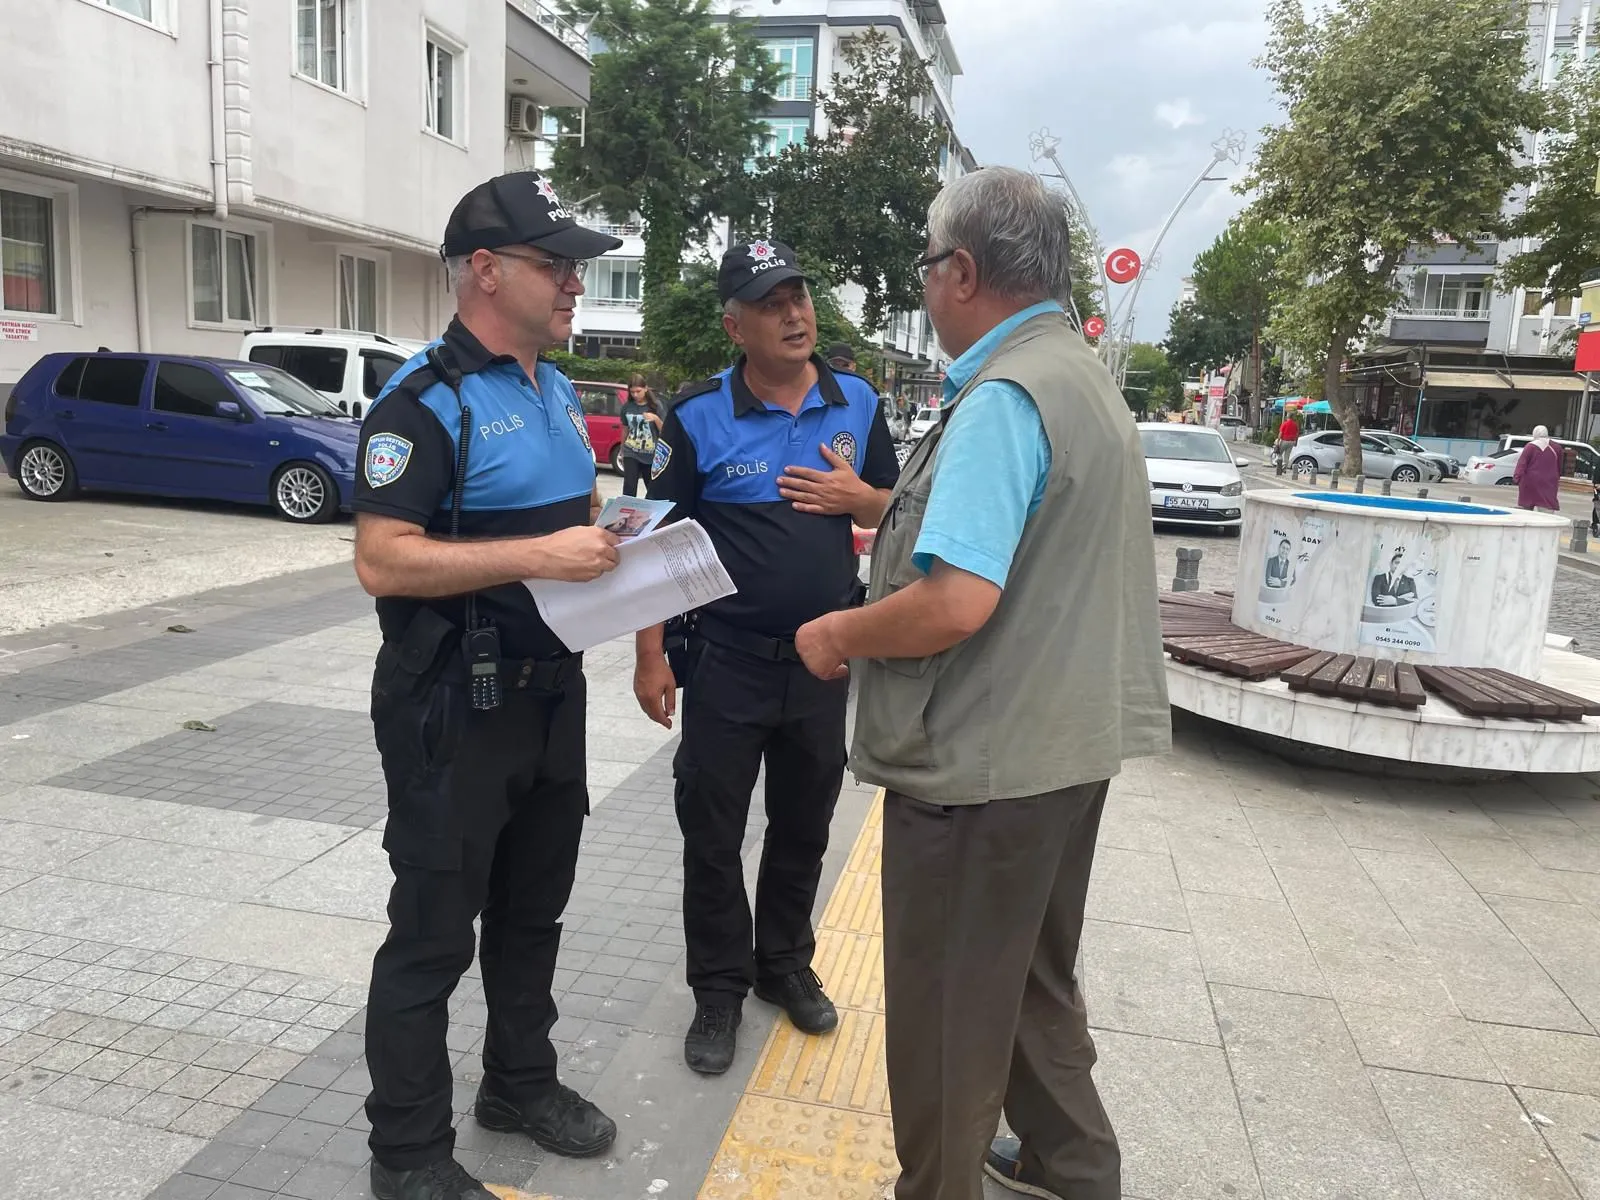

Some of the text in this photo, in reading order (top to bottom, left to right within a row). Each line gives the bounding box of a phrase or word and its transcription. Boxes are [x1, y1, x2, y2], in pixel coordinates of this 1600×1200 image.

[751, 258, 786, 274] POLİS
[480, 413, 525, 440] POLİS
[726, 459, 768, 478] POLİS
[1375, 635, 1391, 643] 0545
